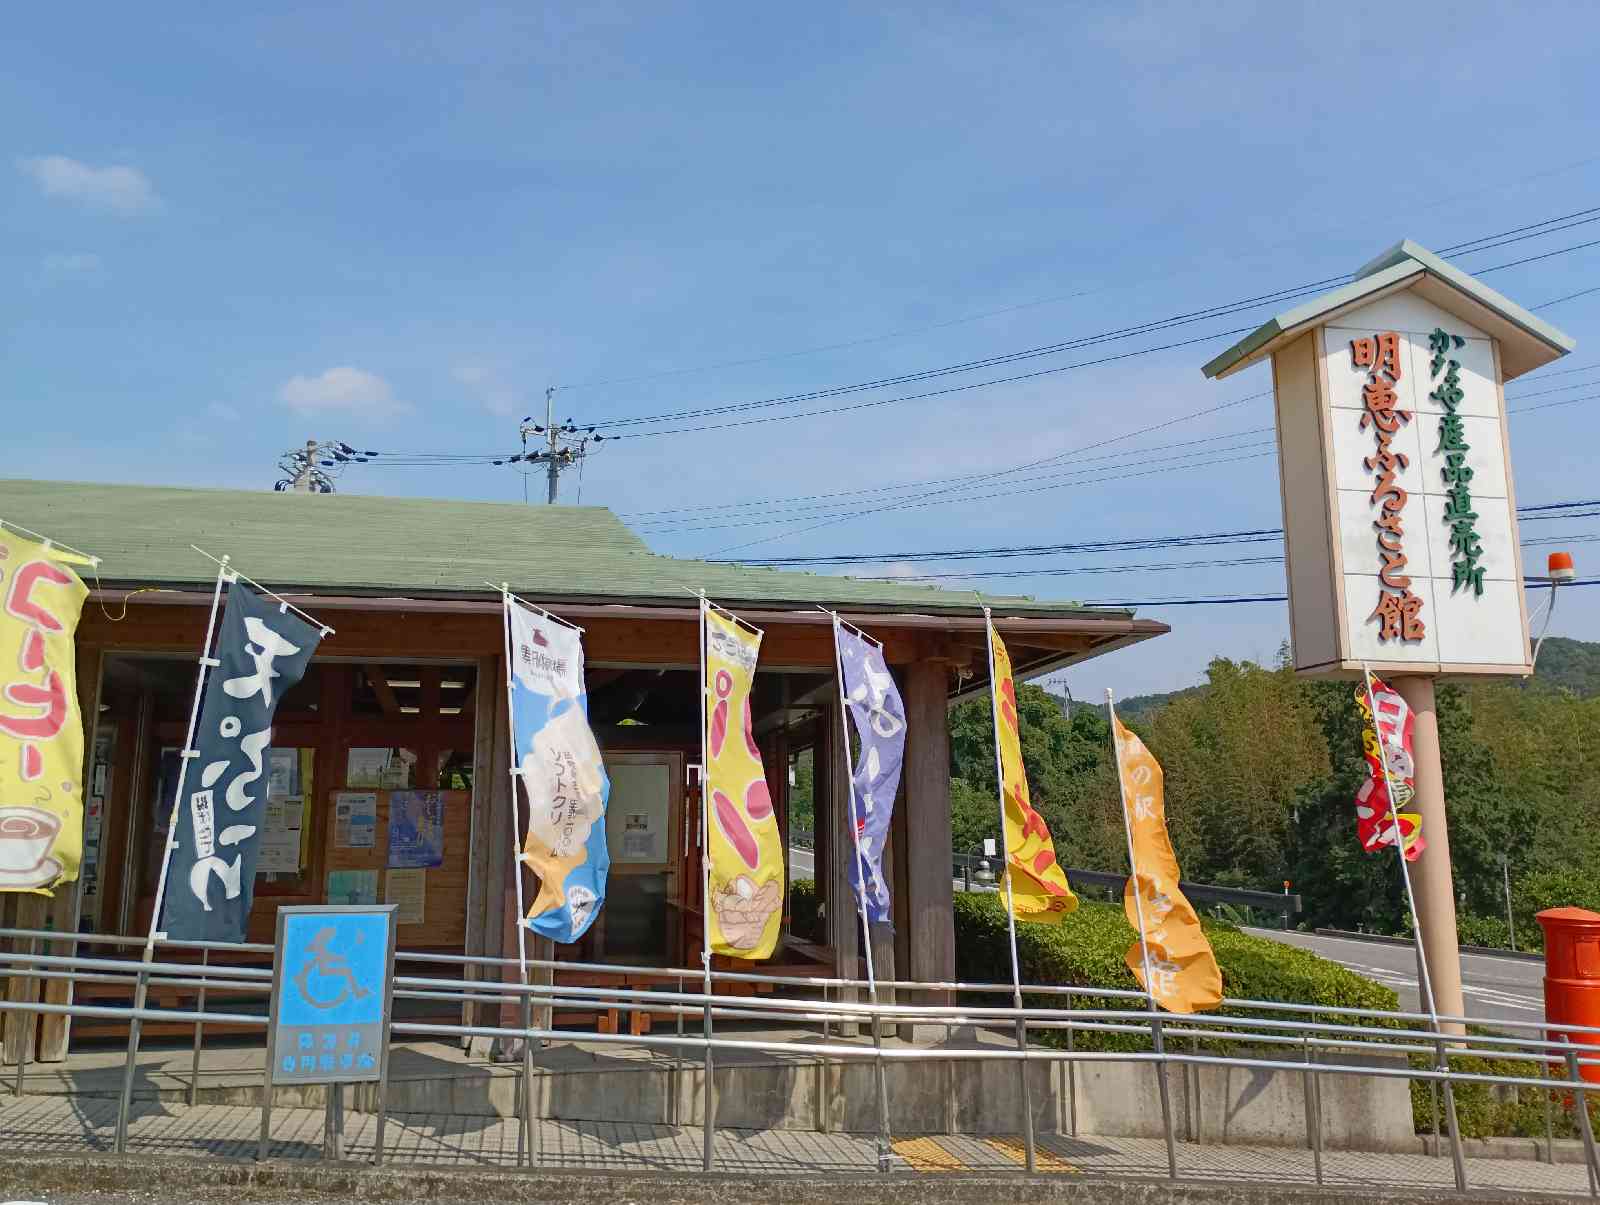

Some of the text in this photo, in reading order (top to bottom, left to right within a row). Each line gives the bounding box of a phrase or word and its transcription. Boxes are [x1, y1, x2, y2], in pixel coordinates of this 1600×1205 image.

[1350, 332, 1426, 641] 明恵ふるさと館
[1429, 328, 1487, 597] かなや産品直売所
[549, 747, 567, 858] ソフトクリム
